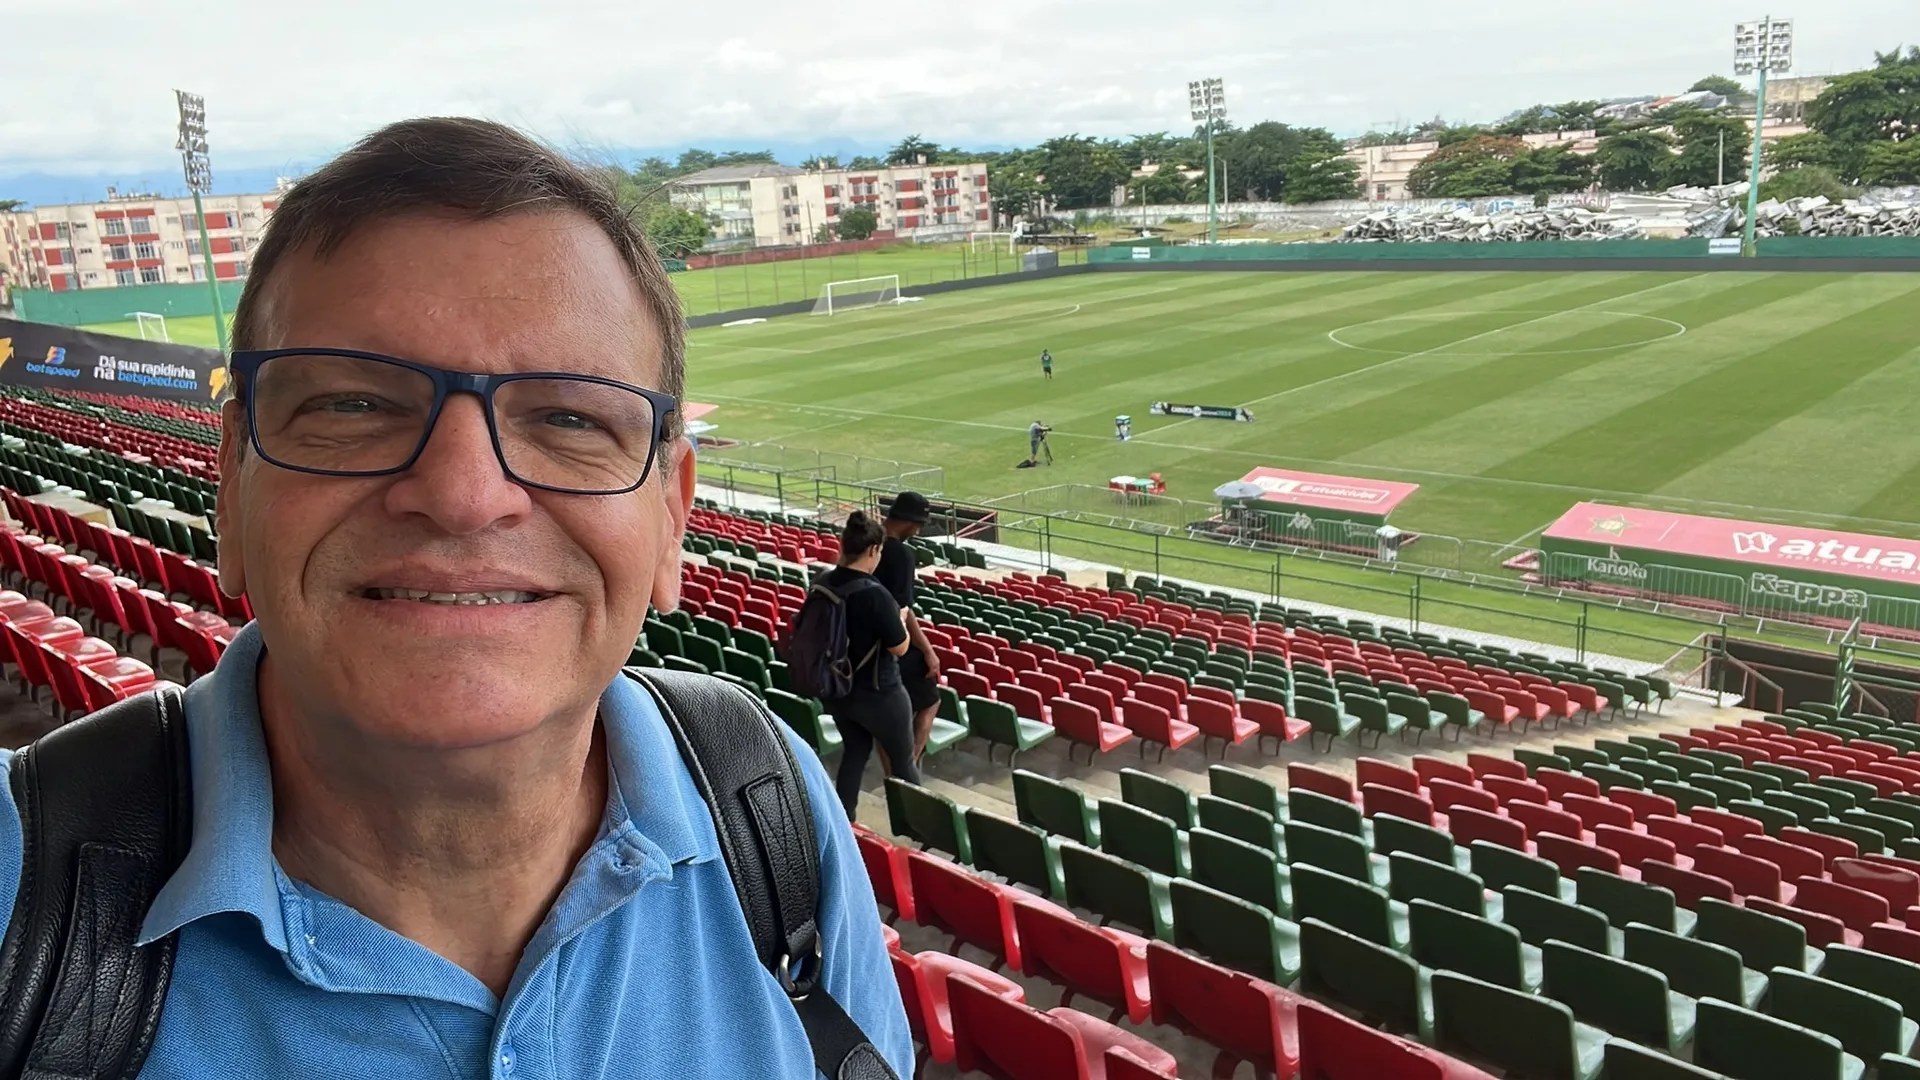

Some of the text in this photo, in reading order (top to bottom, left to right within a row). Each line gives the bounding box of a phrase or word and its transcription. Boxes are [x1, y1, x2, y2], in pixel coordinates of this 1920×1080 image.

[26, 362, 80, 378] betspeed
[94, 366, 198, 390] na betspeed.com
[99, 355, 196, 380] Dá sua rapidinha
[1779, 538, 1920, 571] atua
[1587, 558, 1647, 579] Karioka
[1750, 572, 1868, 609] Kappa
